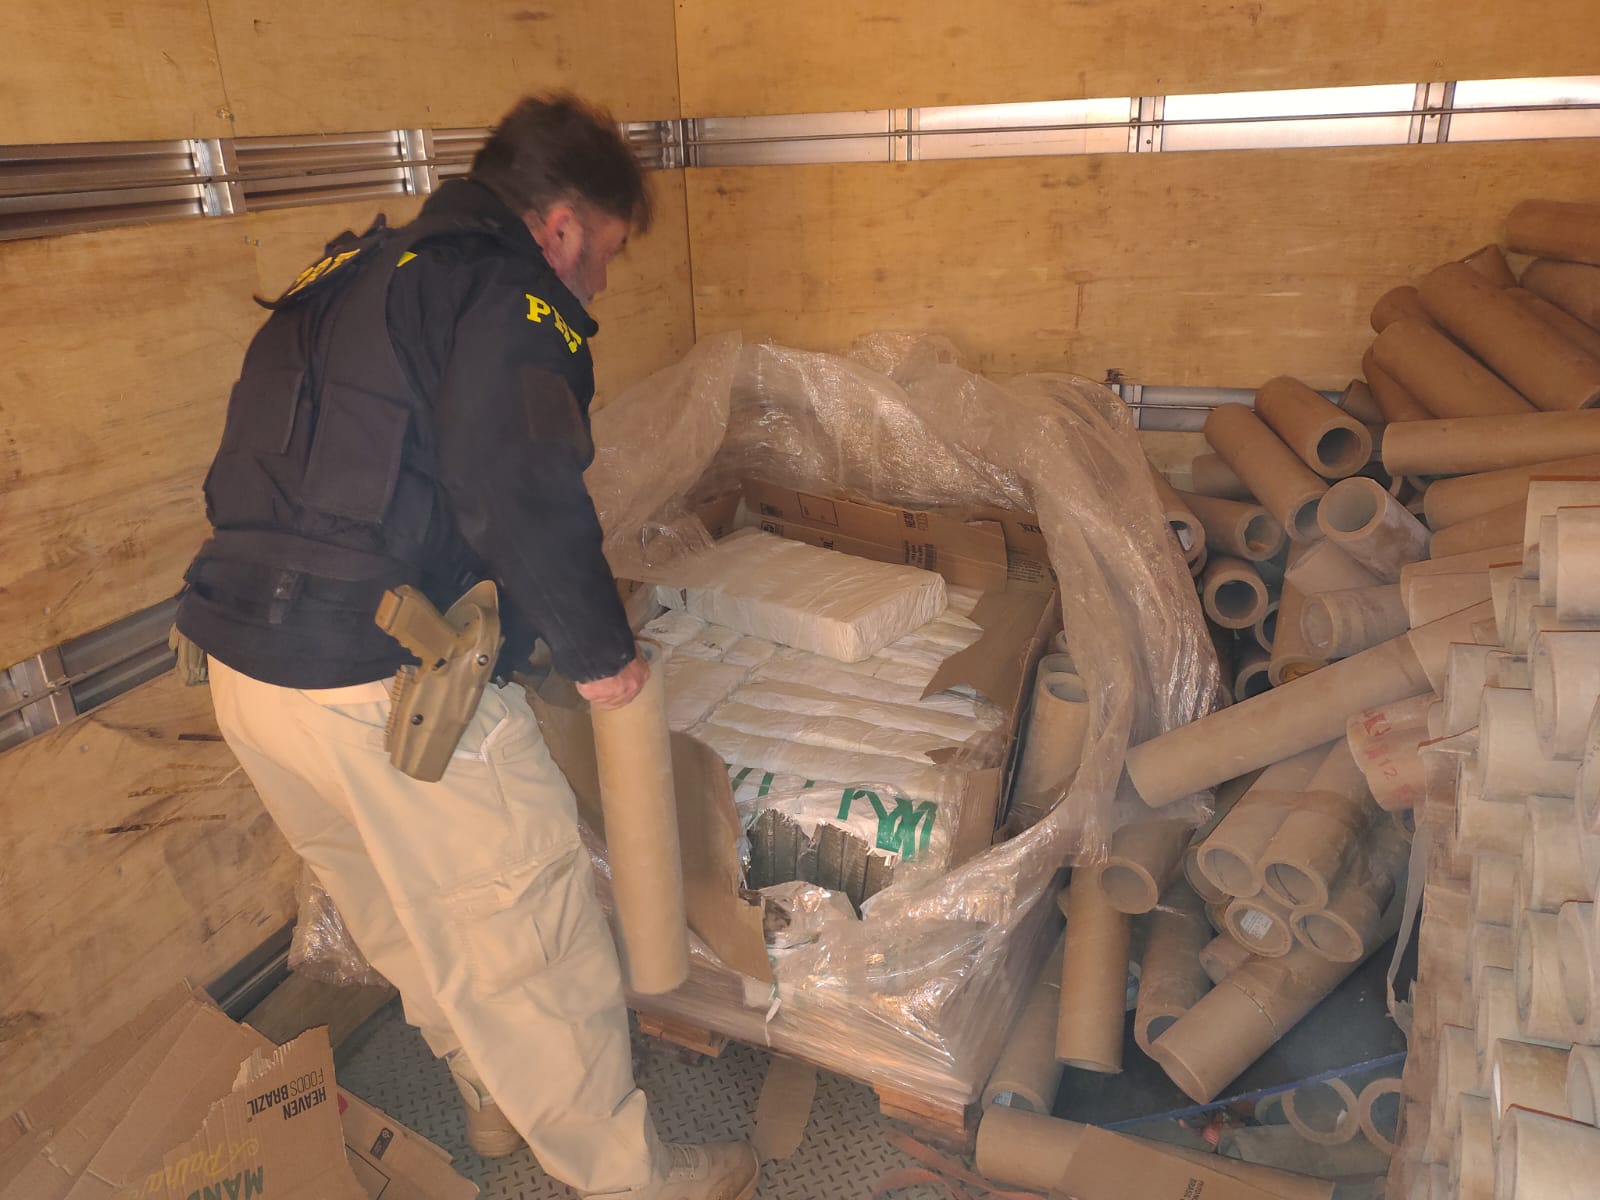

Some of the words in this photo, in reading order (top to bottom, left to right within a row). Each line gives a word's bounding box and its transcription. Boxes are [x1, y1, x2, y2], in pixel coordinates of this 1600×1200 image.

[289, 1067, 325, 1097] FOODS
[247, 1084, 289, 1116] BRAZIL
[282, 1086, 327, 1120] HEAVEN
